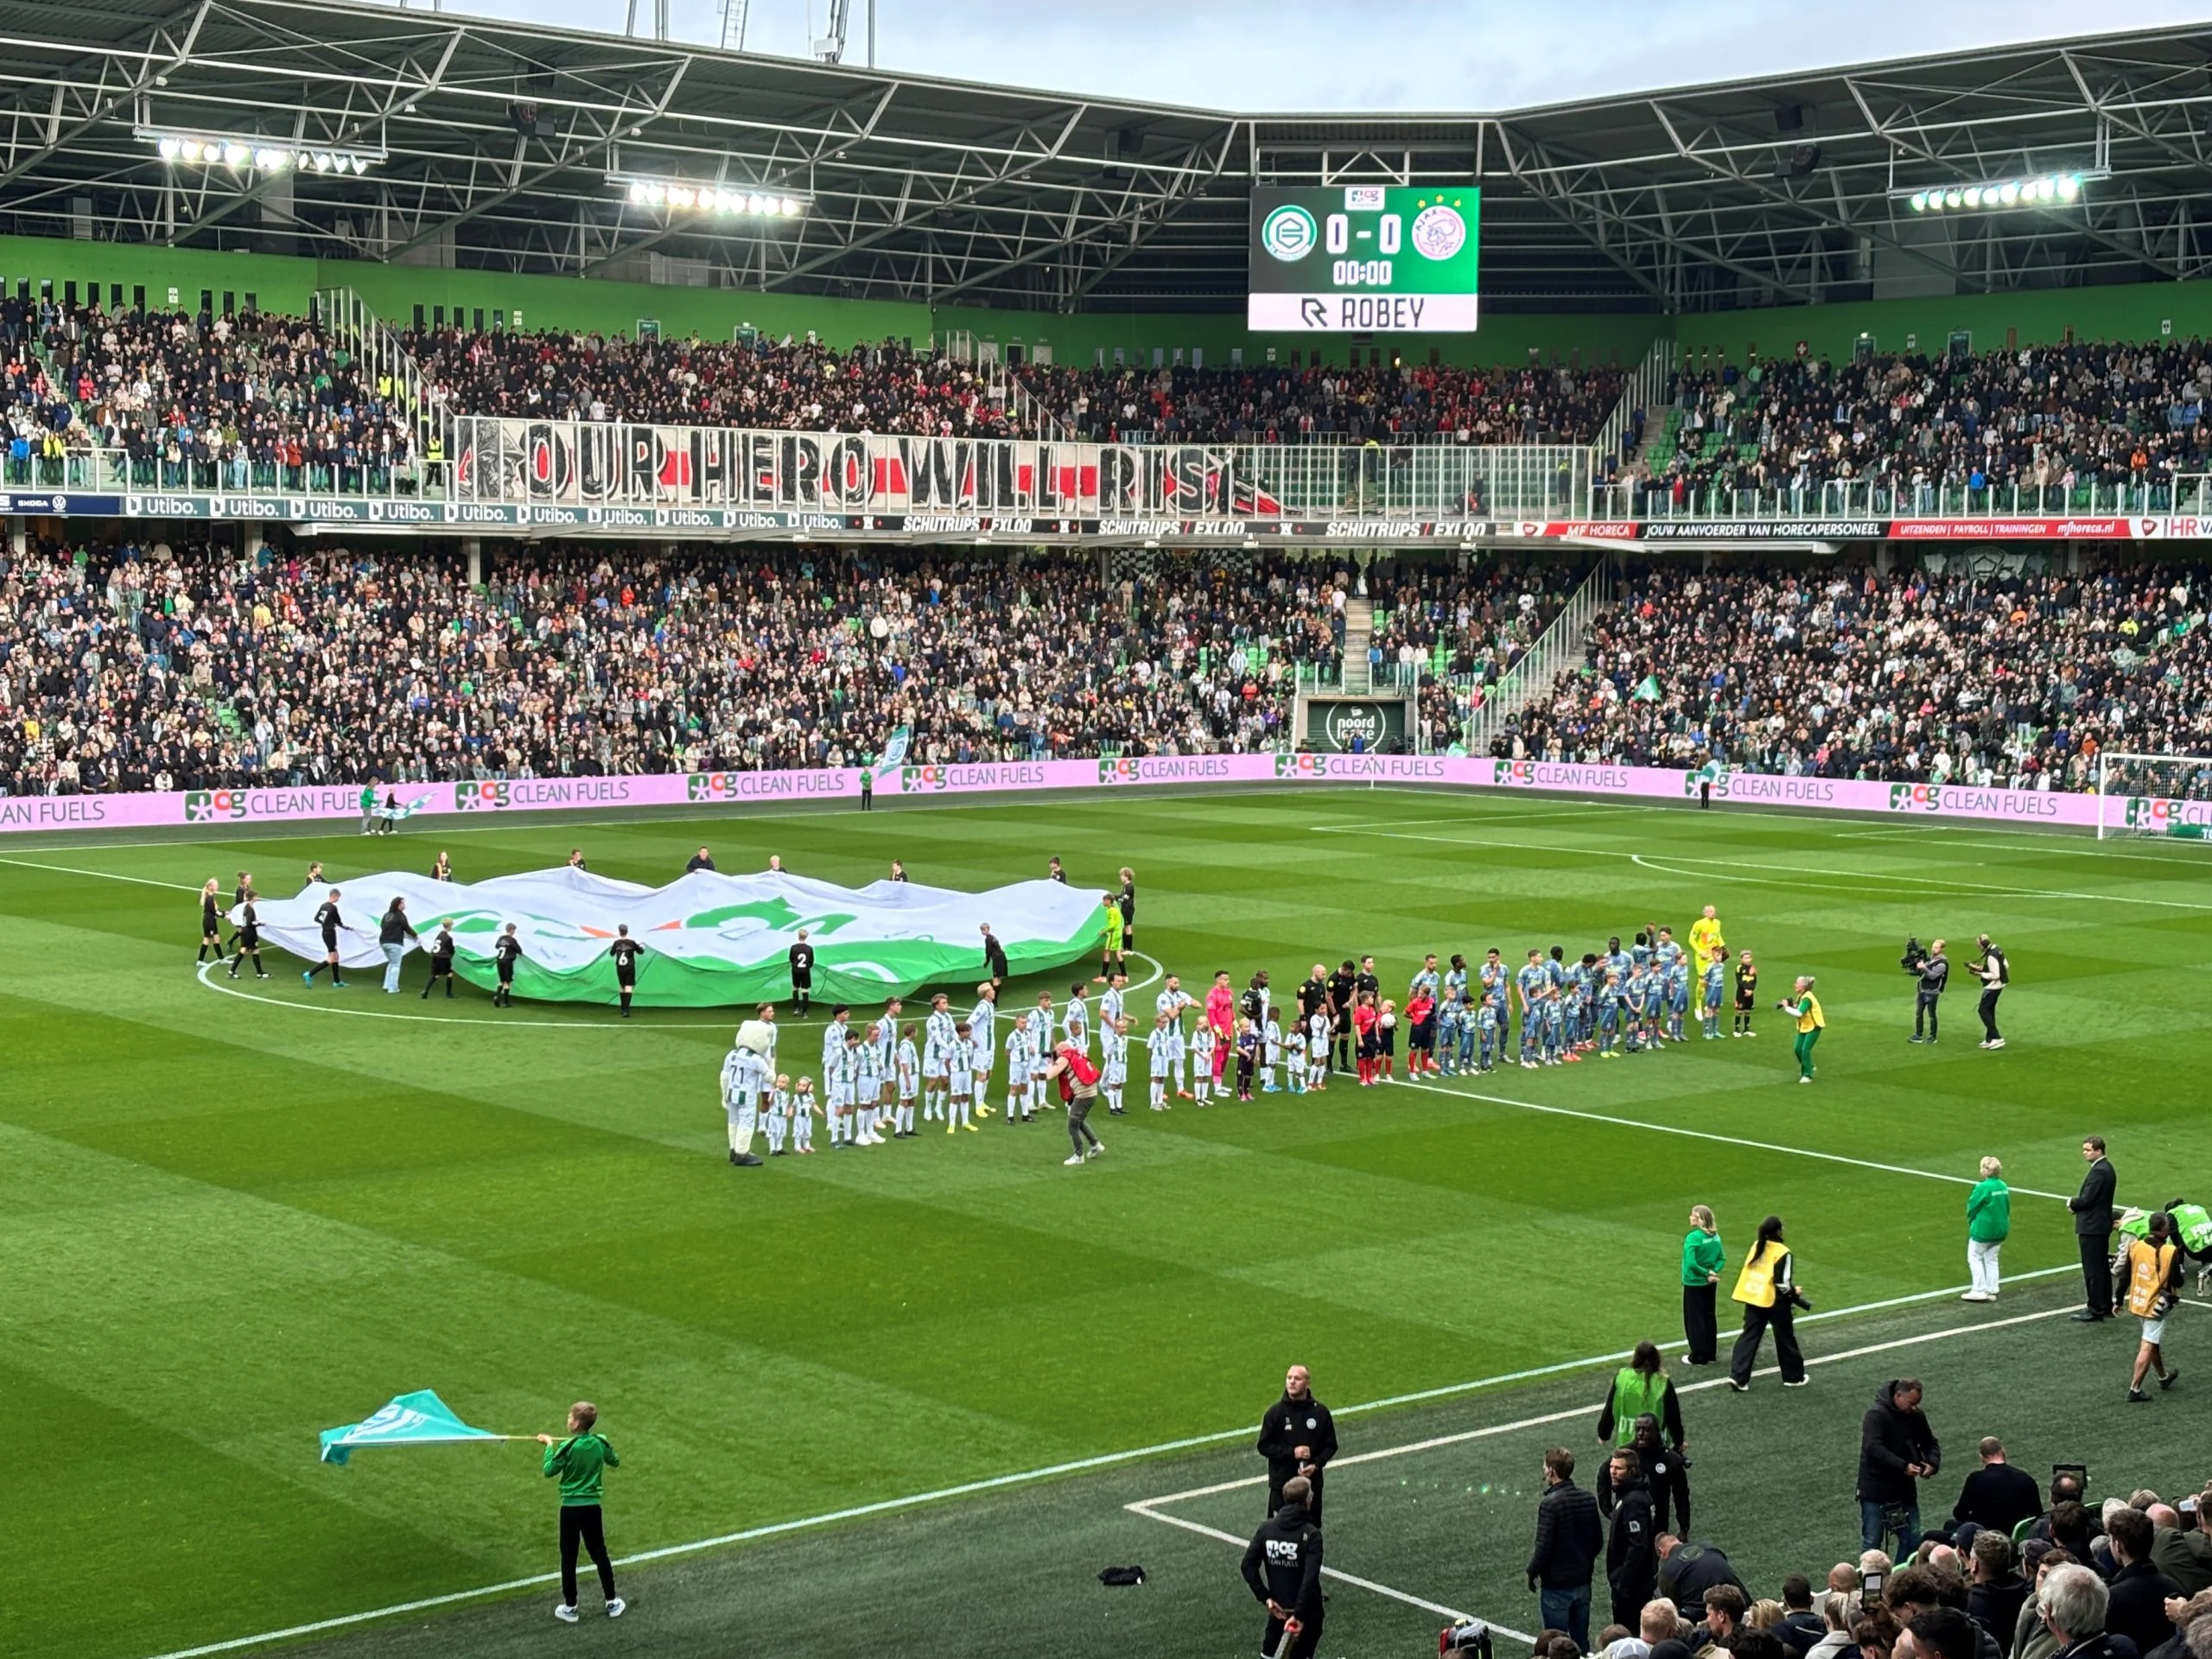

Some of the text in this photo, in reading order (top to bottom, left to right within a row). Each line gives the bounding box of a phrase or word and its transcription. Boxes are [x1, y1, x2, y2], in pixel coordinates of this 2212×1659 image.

[1415, 208, 1438, 232] AJAX
[1326, 213, 1348, 254] 0
[1379, 213, 1402, 254] 0
[1333, 260, 1392, 285] 00:00
[1341, 297, 1425, 328] ROBEY
[518, 423, 669, 501] OUR
[691, 426, 874, 510] HERO
[898, 436, 1065, 512] WILL
[146, 498, 198, 515] Utibo.
[230, 499, 280, 517] Utibo.
[309, 501, 358, 518] Utibo.
[388, 503, 435, 520] Utibo.
[462, 504, 507, 522] Utibo.
[535, 507, 578, 524] Utibo.
[605, 509, 647, 525] Utibo.
[672, 511, 714, 526] Utibo.
[740, 512, 779, 528] Utibo.
[804, 515, 842, 530] Utibo.
[903, 516, 980, 532] SCHUTRUPS
[991, 517, 1033, 533] EXLOO
[1098, 519, 1181, 535] SCHUTRUPS
[1193, 521, 1245, 535] EXLOO
[1325, 522, 1421, 537] SCHUTRUPS
[1567, 524, 1630, 537] MF HORECA
[1644, 523, 1880, 538] JOUW AANVOERDER VAN HORECAPERSONEEL
[1900, 524, 1946, 534] UITZENDEN
[1954, 524, 1988, 535] PAYROLL
[1994, 523, 2047, 534] TRAININGEN
[2056, 520, 2115, 537] mfhoreca.nl
[2171, 518, 2197, 537] HR
[1337, 715, 1376, 729] noord
[950, 767, 998, 786] CLEAN
[1001, 766, 1044, 784] FUELS
[1142, 760, 1185, 779] CLEAN
[1188, 758, 1230, 776] FUELS
[1330, 758, 1384, 776] CLEAN
[1390, 759, 1445, 777] FUELS
[741, 775, 794, 795] CLEAN
[797, 772, 845, 791] FUELS
[1537, 766, 1582, 785] CLEAN
[1585, 768, 1628, 788] FUELS
[513, 784, 571, 804] CLEAN
[576, 781, 630, 801] FUELS
[1732, 778, 1782, 797] CLEAN
[1785, 781, 1834, 801] FUELS
[40, 800, 105, 823] FUELS
[251, 791, 316, 815] CLEAN
[1943, 791, 1998, 812] CLEAN
[2004, 795, 2057, 816] FUELS
[797, 953, 807, 968] 2
